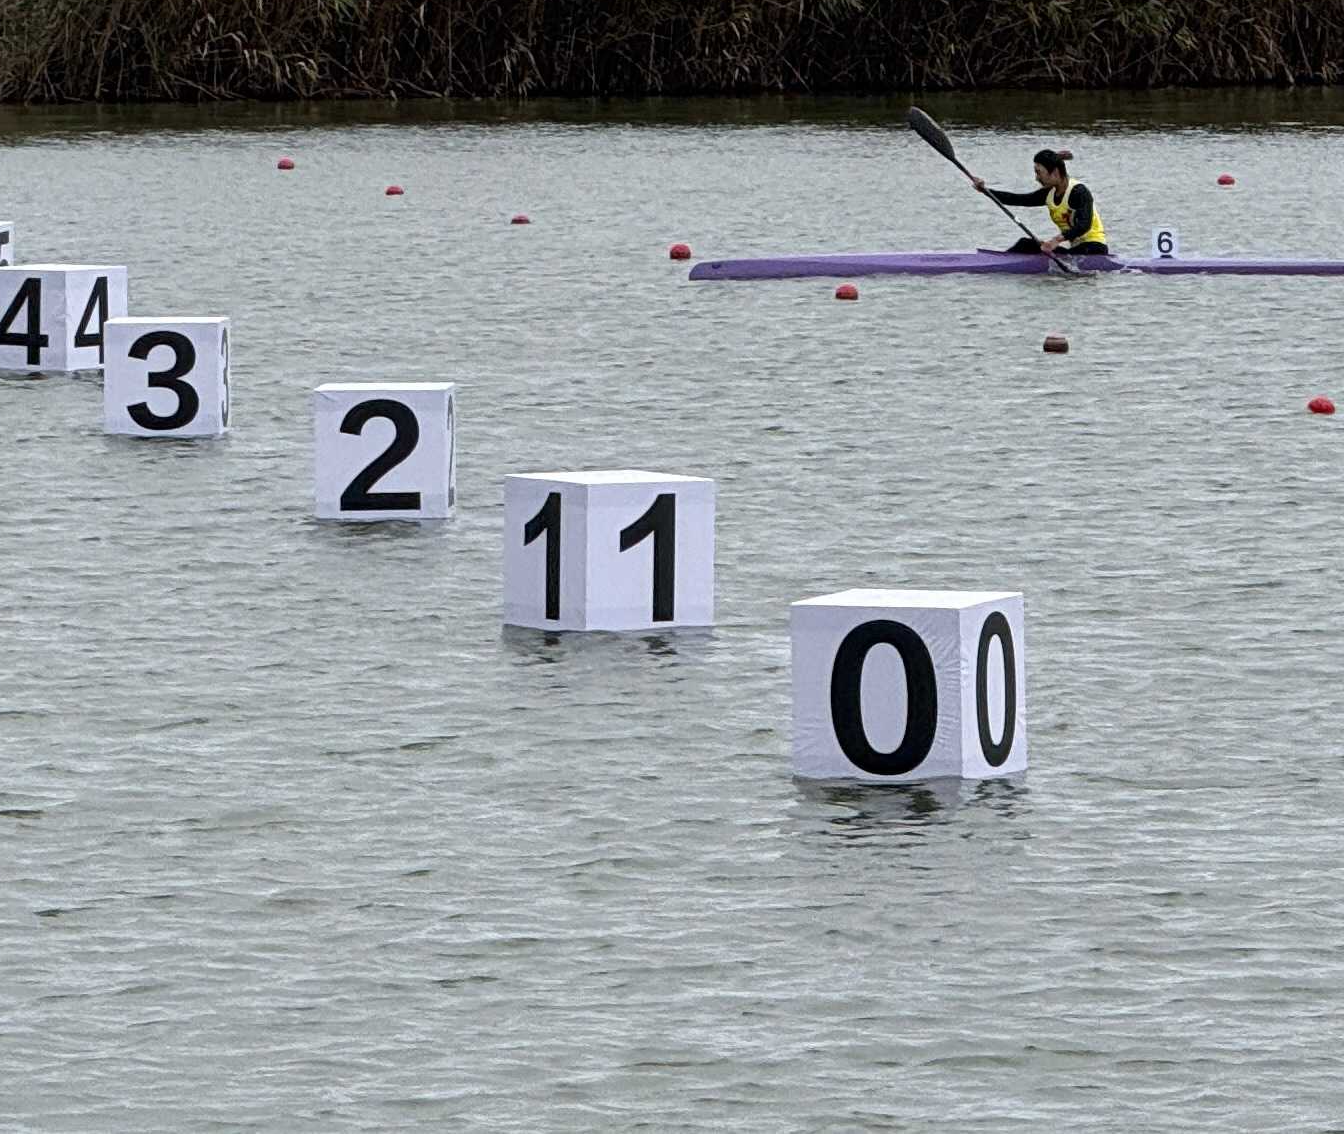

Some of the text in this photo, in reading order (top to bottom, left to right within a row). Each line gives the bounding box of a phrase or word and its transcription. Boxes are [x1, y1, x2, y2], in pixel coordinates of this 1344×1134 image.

[1157, 231, 1173, 254] 6
[74, 276, 109, 365] 4
[126, 330, 200, 431] 3
[339, 398, 422, 512] 2
[523, 491, 562, 621] 1
[619, 493, 676, 623] 1
[830, 619, 939, 776] 0
[975, 611, 1017, 768] 0
